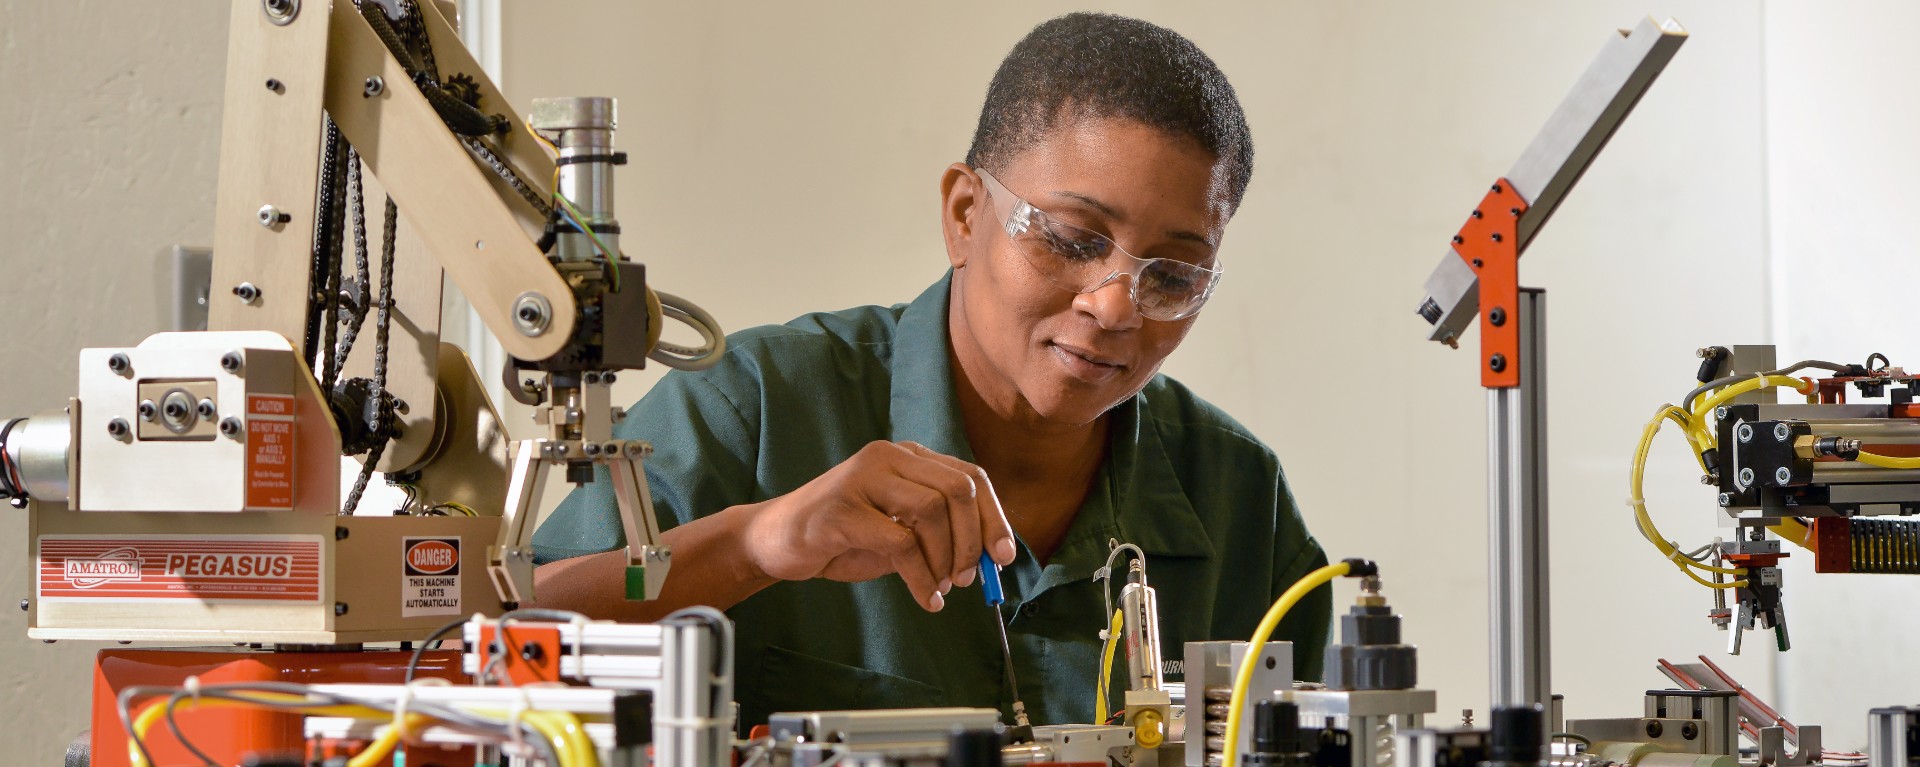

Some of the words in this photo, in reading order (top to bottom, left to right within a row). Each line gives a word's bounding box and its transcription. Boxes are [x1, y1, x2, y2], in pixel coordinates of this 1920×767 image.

[256, 400, 285, 412] CAUTION
[251, 422, 260, 432] DO
[261, 423, 272, 433] NOT
[273, 423, 289, 433] MOVE
[263, 434, 276, 443] AXIS
[266, 445, 278, 454] AXIS
[255, 454, 286, 464] MANUALLY
[414, 548, 451, 566] DANGER
[69, 562, 137, 575] AMATROL
[169, 554, 289, 577] PEGASUS
[409, 578, 424, 587] THIS
[426, 578, 455, 587] MACHINE
[420, 588, 445, 597] STARTS
[405, 598, 459, 608] AUTOMATICALLY
[1161, 660, 1185, 674] URN
